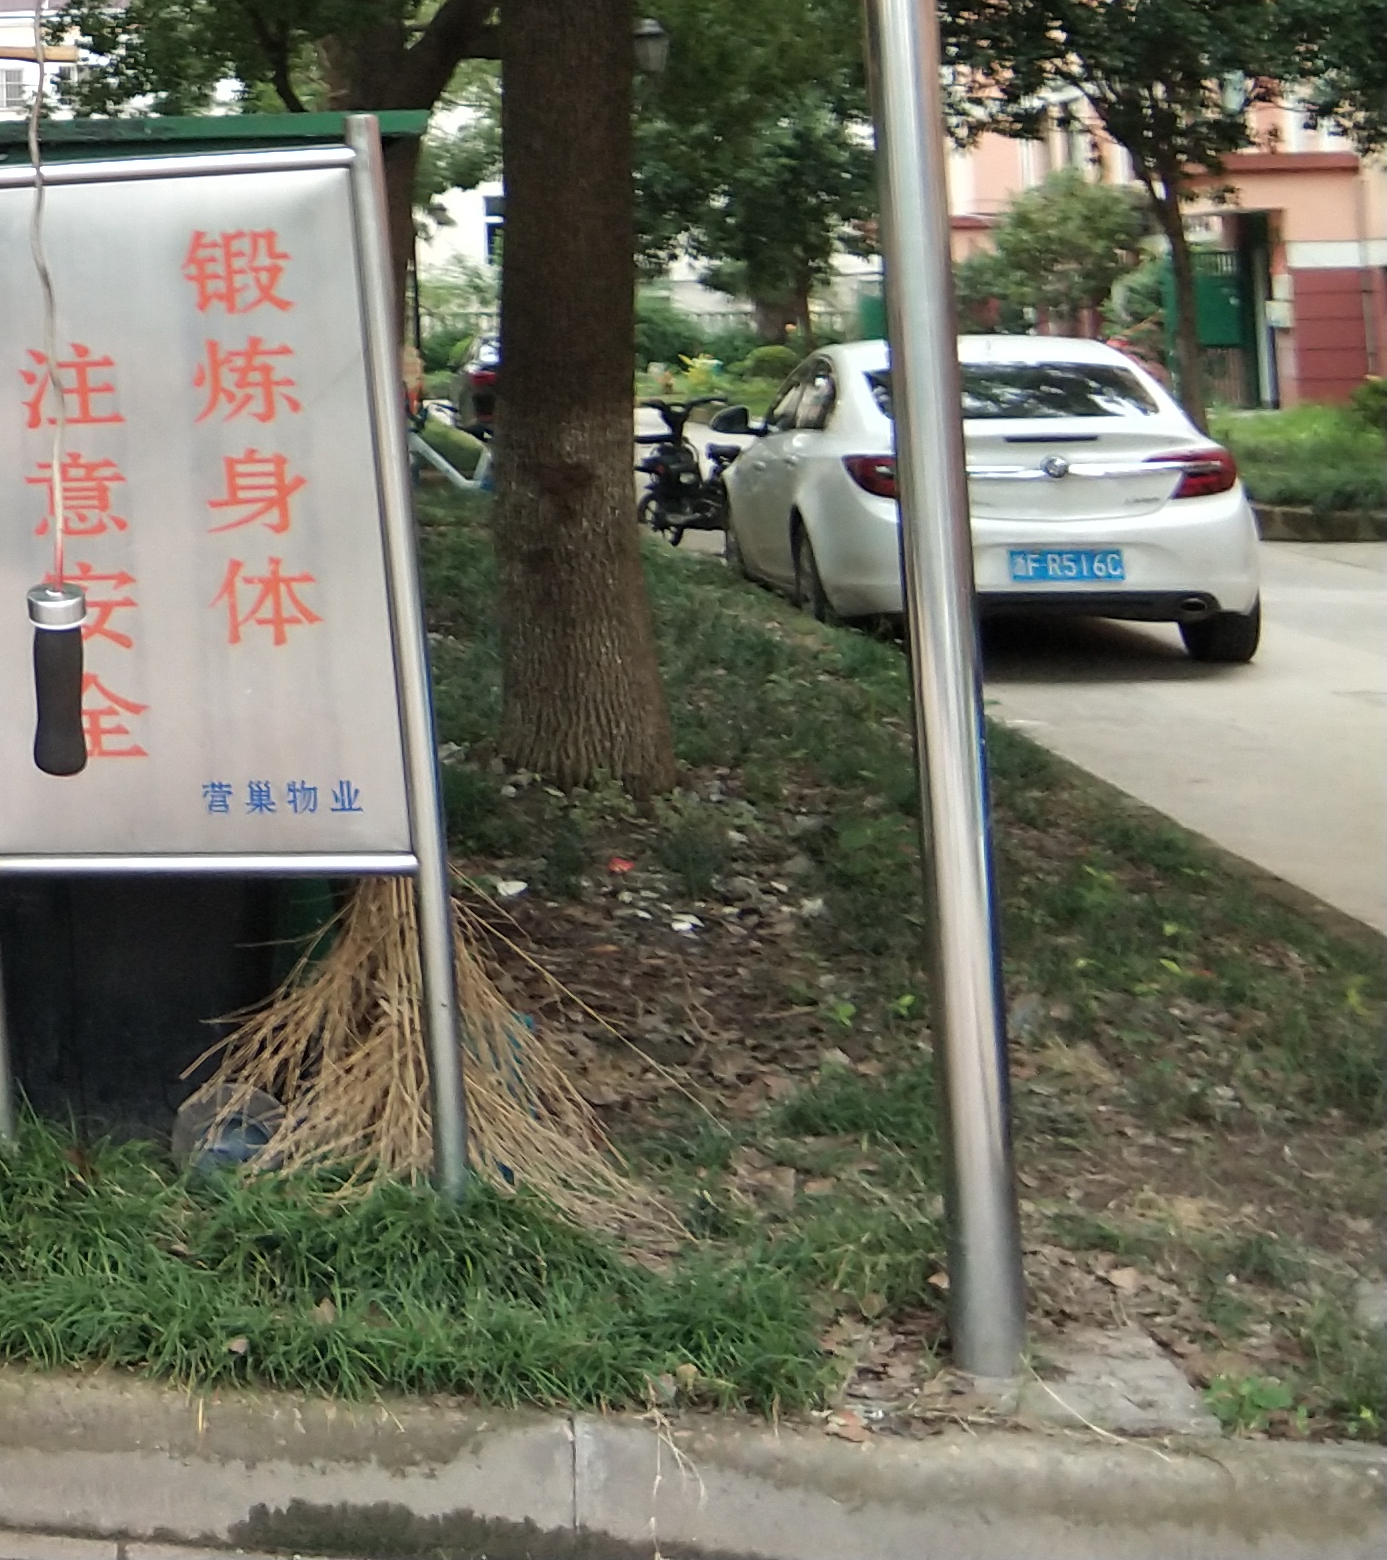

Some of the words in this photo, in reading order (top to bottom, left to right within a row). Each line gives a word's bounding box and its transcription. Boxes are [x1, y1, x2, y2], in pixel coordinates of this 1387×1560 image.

[19, 342, 150, 759] 注意安全
[180, 228, 323, 646] 锻炼身体
[201, 779, 365, 815] 营巢物业
